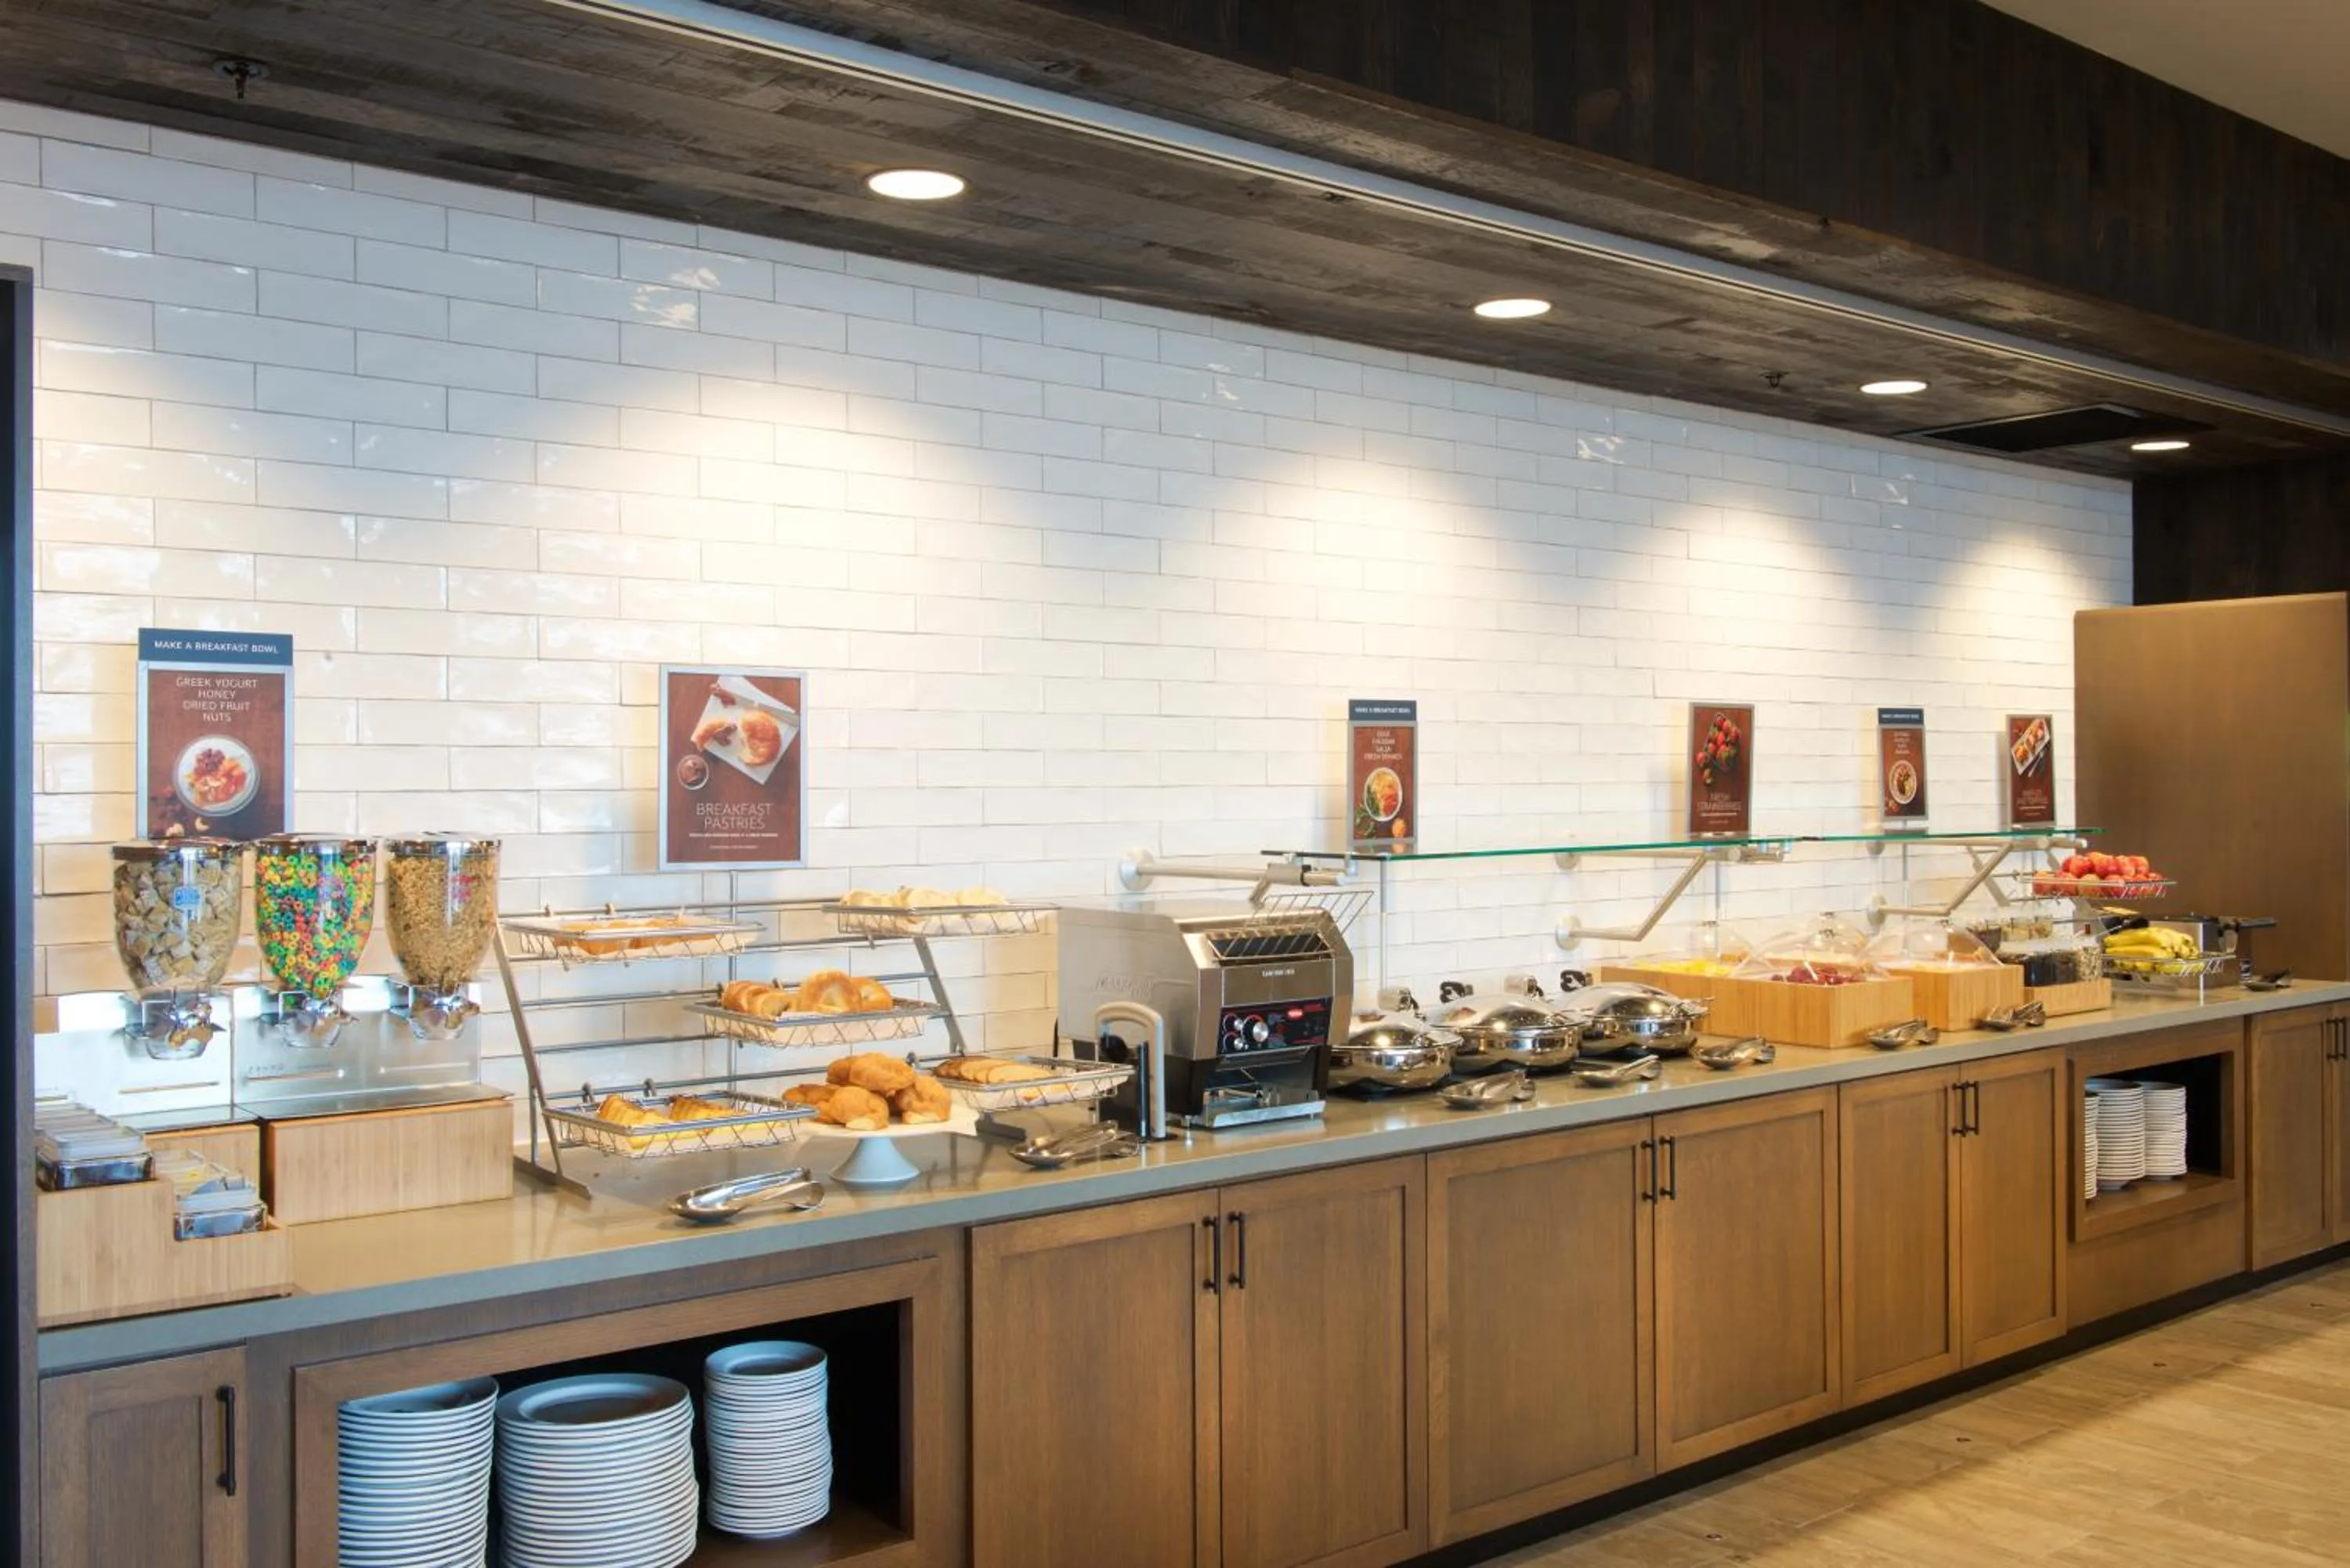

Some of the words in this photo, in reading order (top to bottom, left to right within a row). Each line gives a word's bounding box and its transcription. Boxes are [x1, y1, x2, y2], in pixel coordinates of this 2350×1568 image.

[154, 641, 182, 649] MAKE
[196, 641, 248, 652] BREAKFAST
[251, 645, 279, 654] BOWL
[176, 677, 212, 688] GREEK
[215, 678, 258, 688] YOGURT
[198, 688, 236, 699] HONEY
[183, 699, 217, 710] DRIED
[220, 701, 251, 711] FRUIT
[203, 712, 232, 722] NUTS
[696, 802, 772, 815] BREAKFAST
[704, 816, 765, 829] PASTRIES
